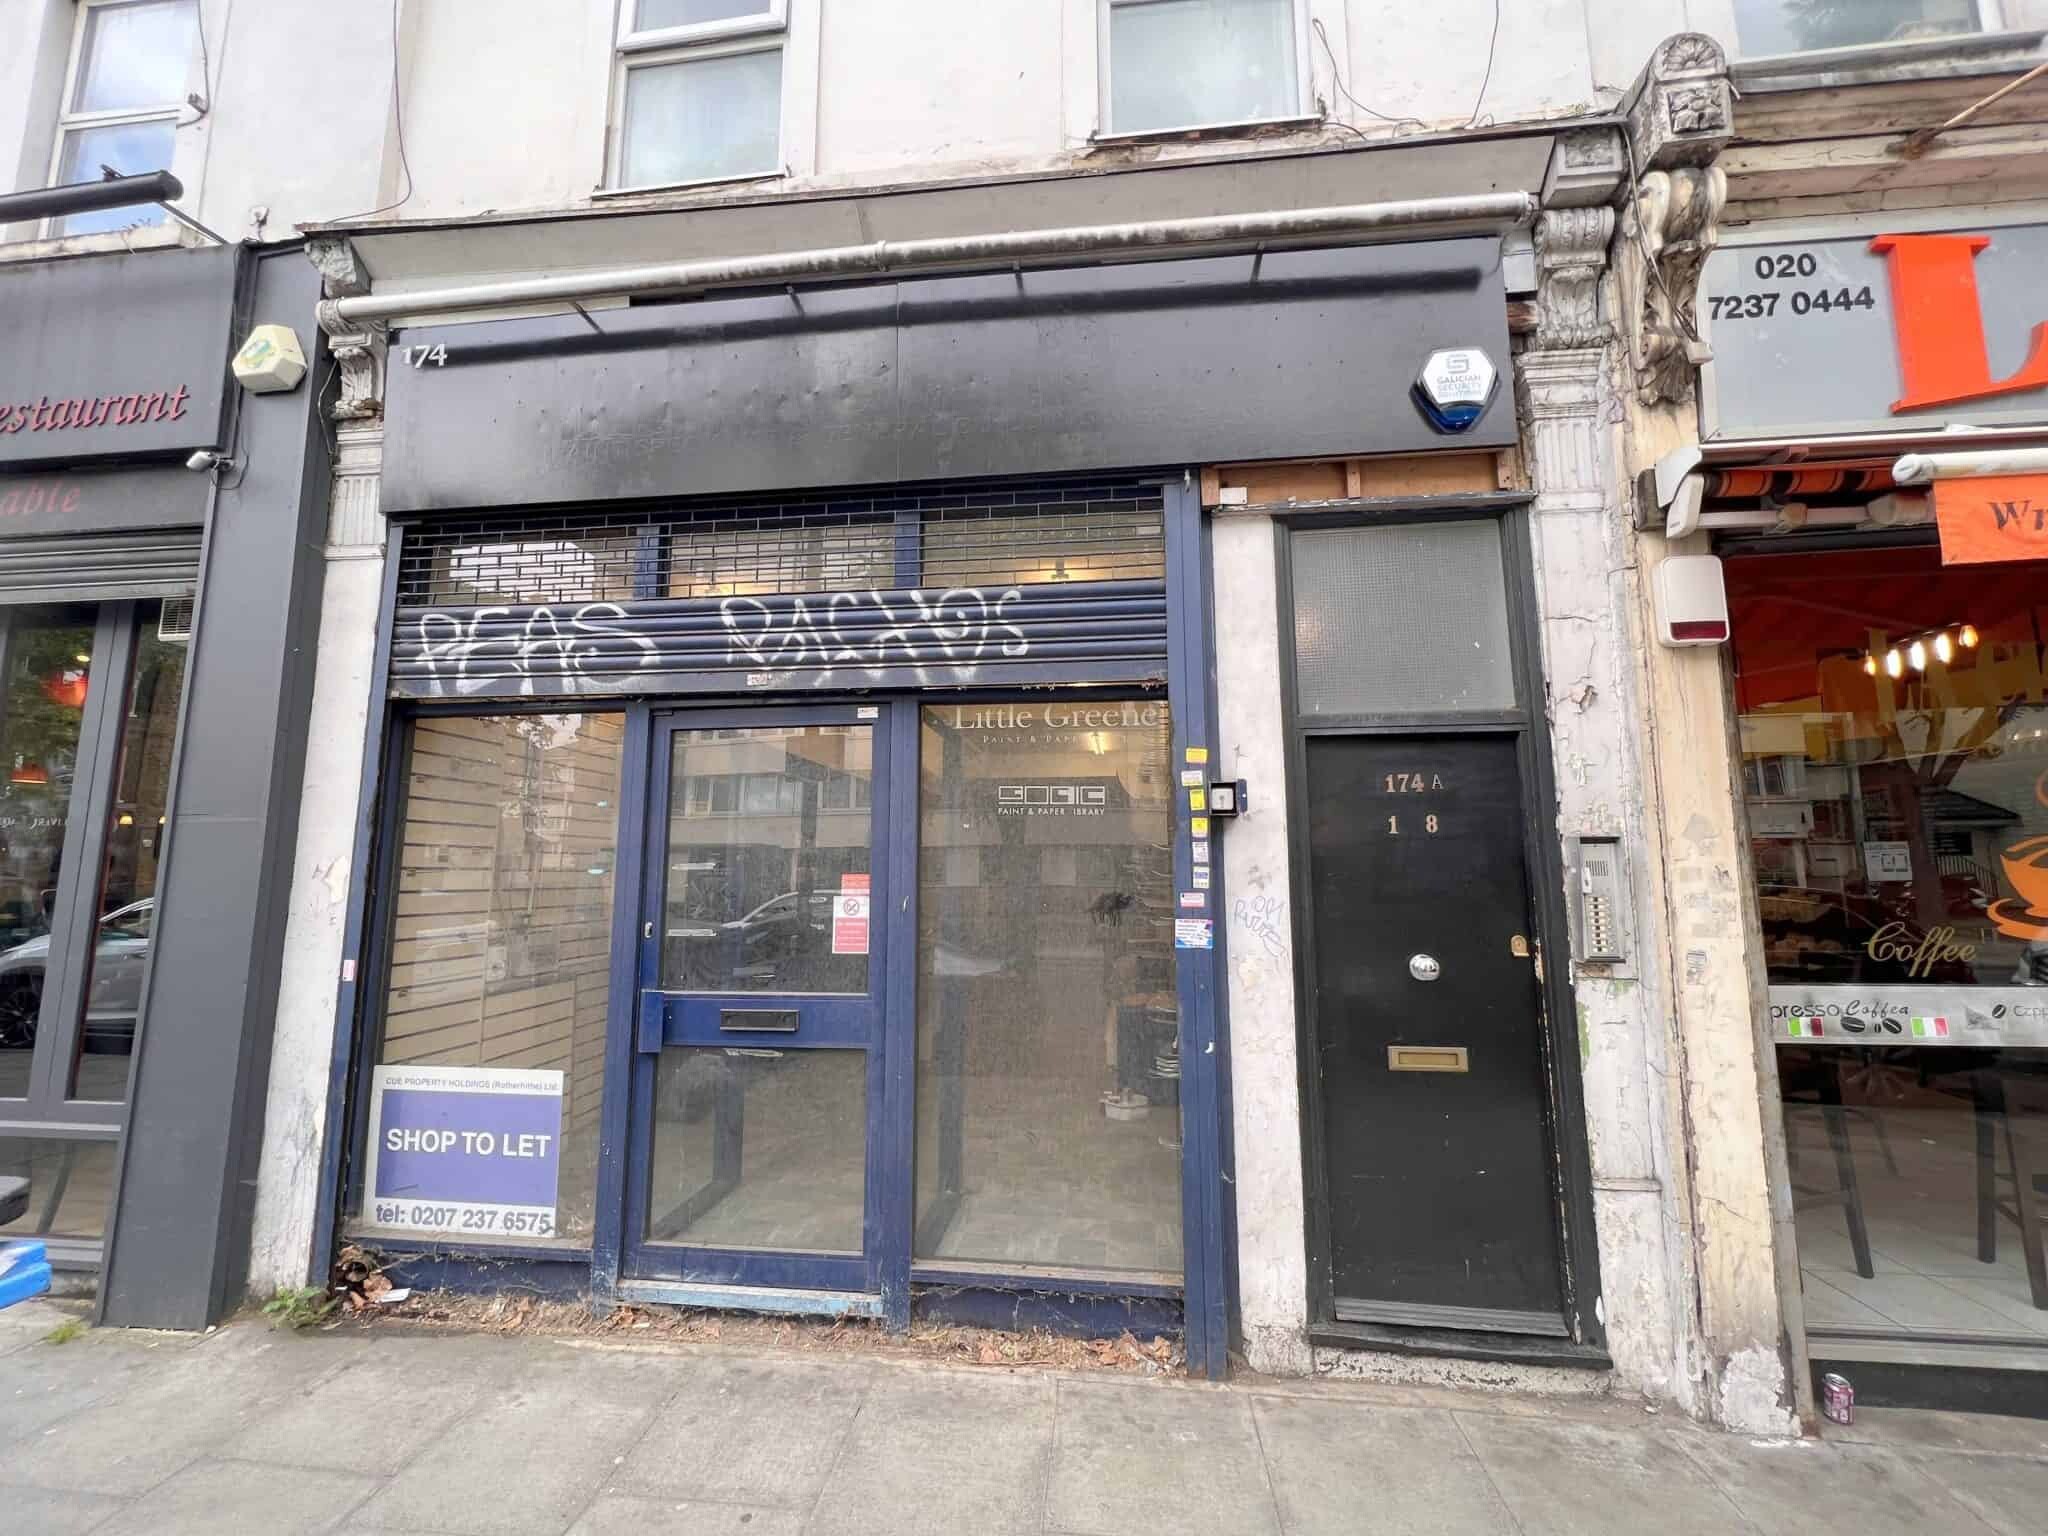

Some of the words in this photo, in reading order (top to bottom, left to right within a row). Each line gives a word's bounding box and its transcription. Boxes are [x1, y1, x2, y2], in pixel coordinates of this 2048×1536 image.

[1755, 253, 1817, 279] 020
[1708, 293, 1780, 320] 7237
[1791, 286, 1875, 315] 0444
[400, 344, 448, 369] 174
[953, 703, 1033, 729] Little
[1044, 703, 1160, 729] Greene
[1385, 773, 1424, 793] 174
[1431, 773, 1445, 790] A
[1028, 807, 1035, 816] &
[1388, 815, 1399, 834] 1
[1425, 814, 1439, 833] 8
[1862, 922, 1977, 978] Coffee
[448, 1079, 490, 1089] HOLDINGS
[386, 1129, 457, 1153] SHOP
[461, 1132, 495, 1155] TO
[502, 1134, 552, 1158] LET
[411, 1206, 456, 1227] 0207
[462, 1210, 499, 1229] 237
[503, 1211, 551, 1232] 6575
